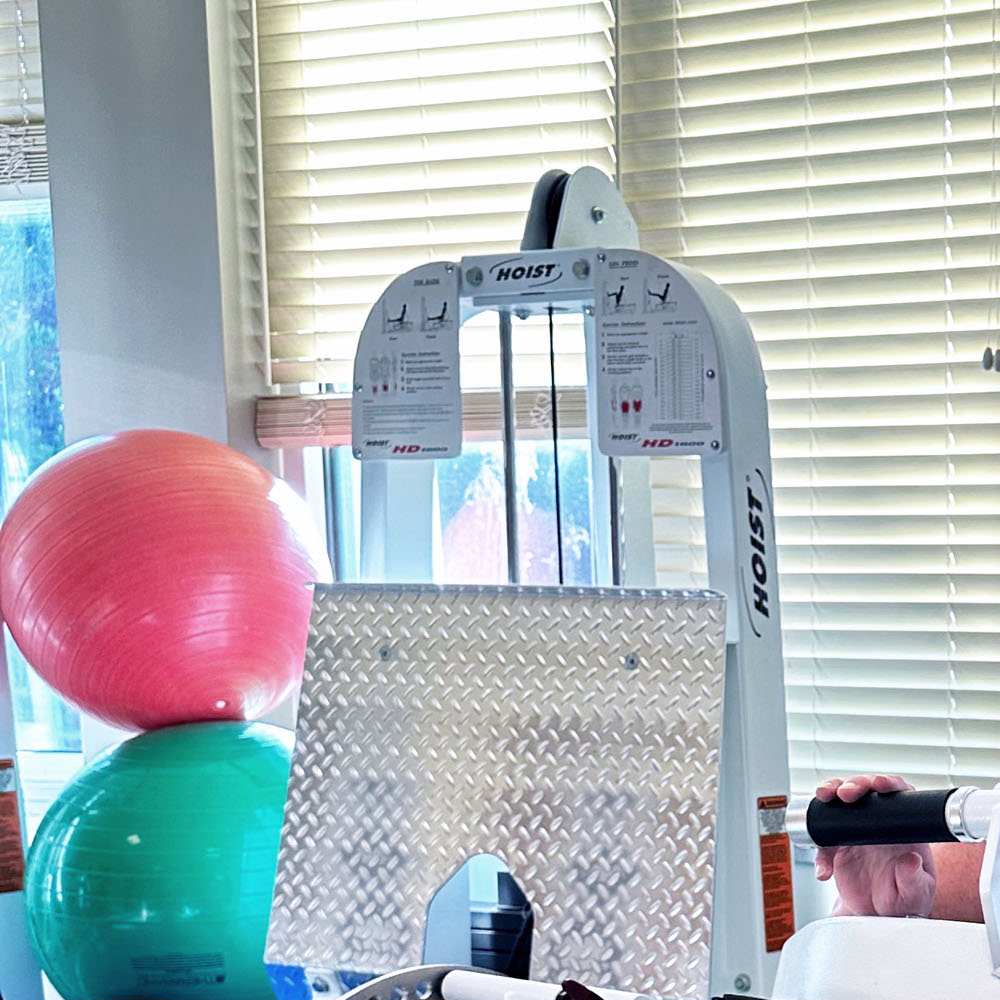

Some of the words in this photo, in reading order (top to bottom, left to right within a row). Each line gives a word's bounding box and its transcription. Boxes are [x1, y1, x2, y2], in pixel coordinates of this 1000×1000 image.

[496, 264, 556, 281] HOIST
[392, 445, 421, 454] HD
[642, 439, 674, 448] HD
[747, 486, 770, 618] HOIST
